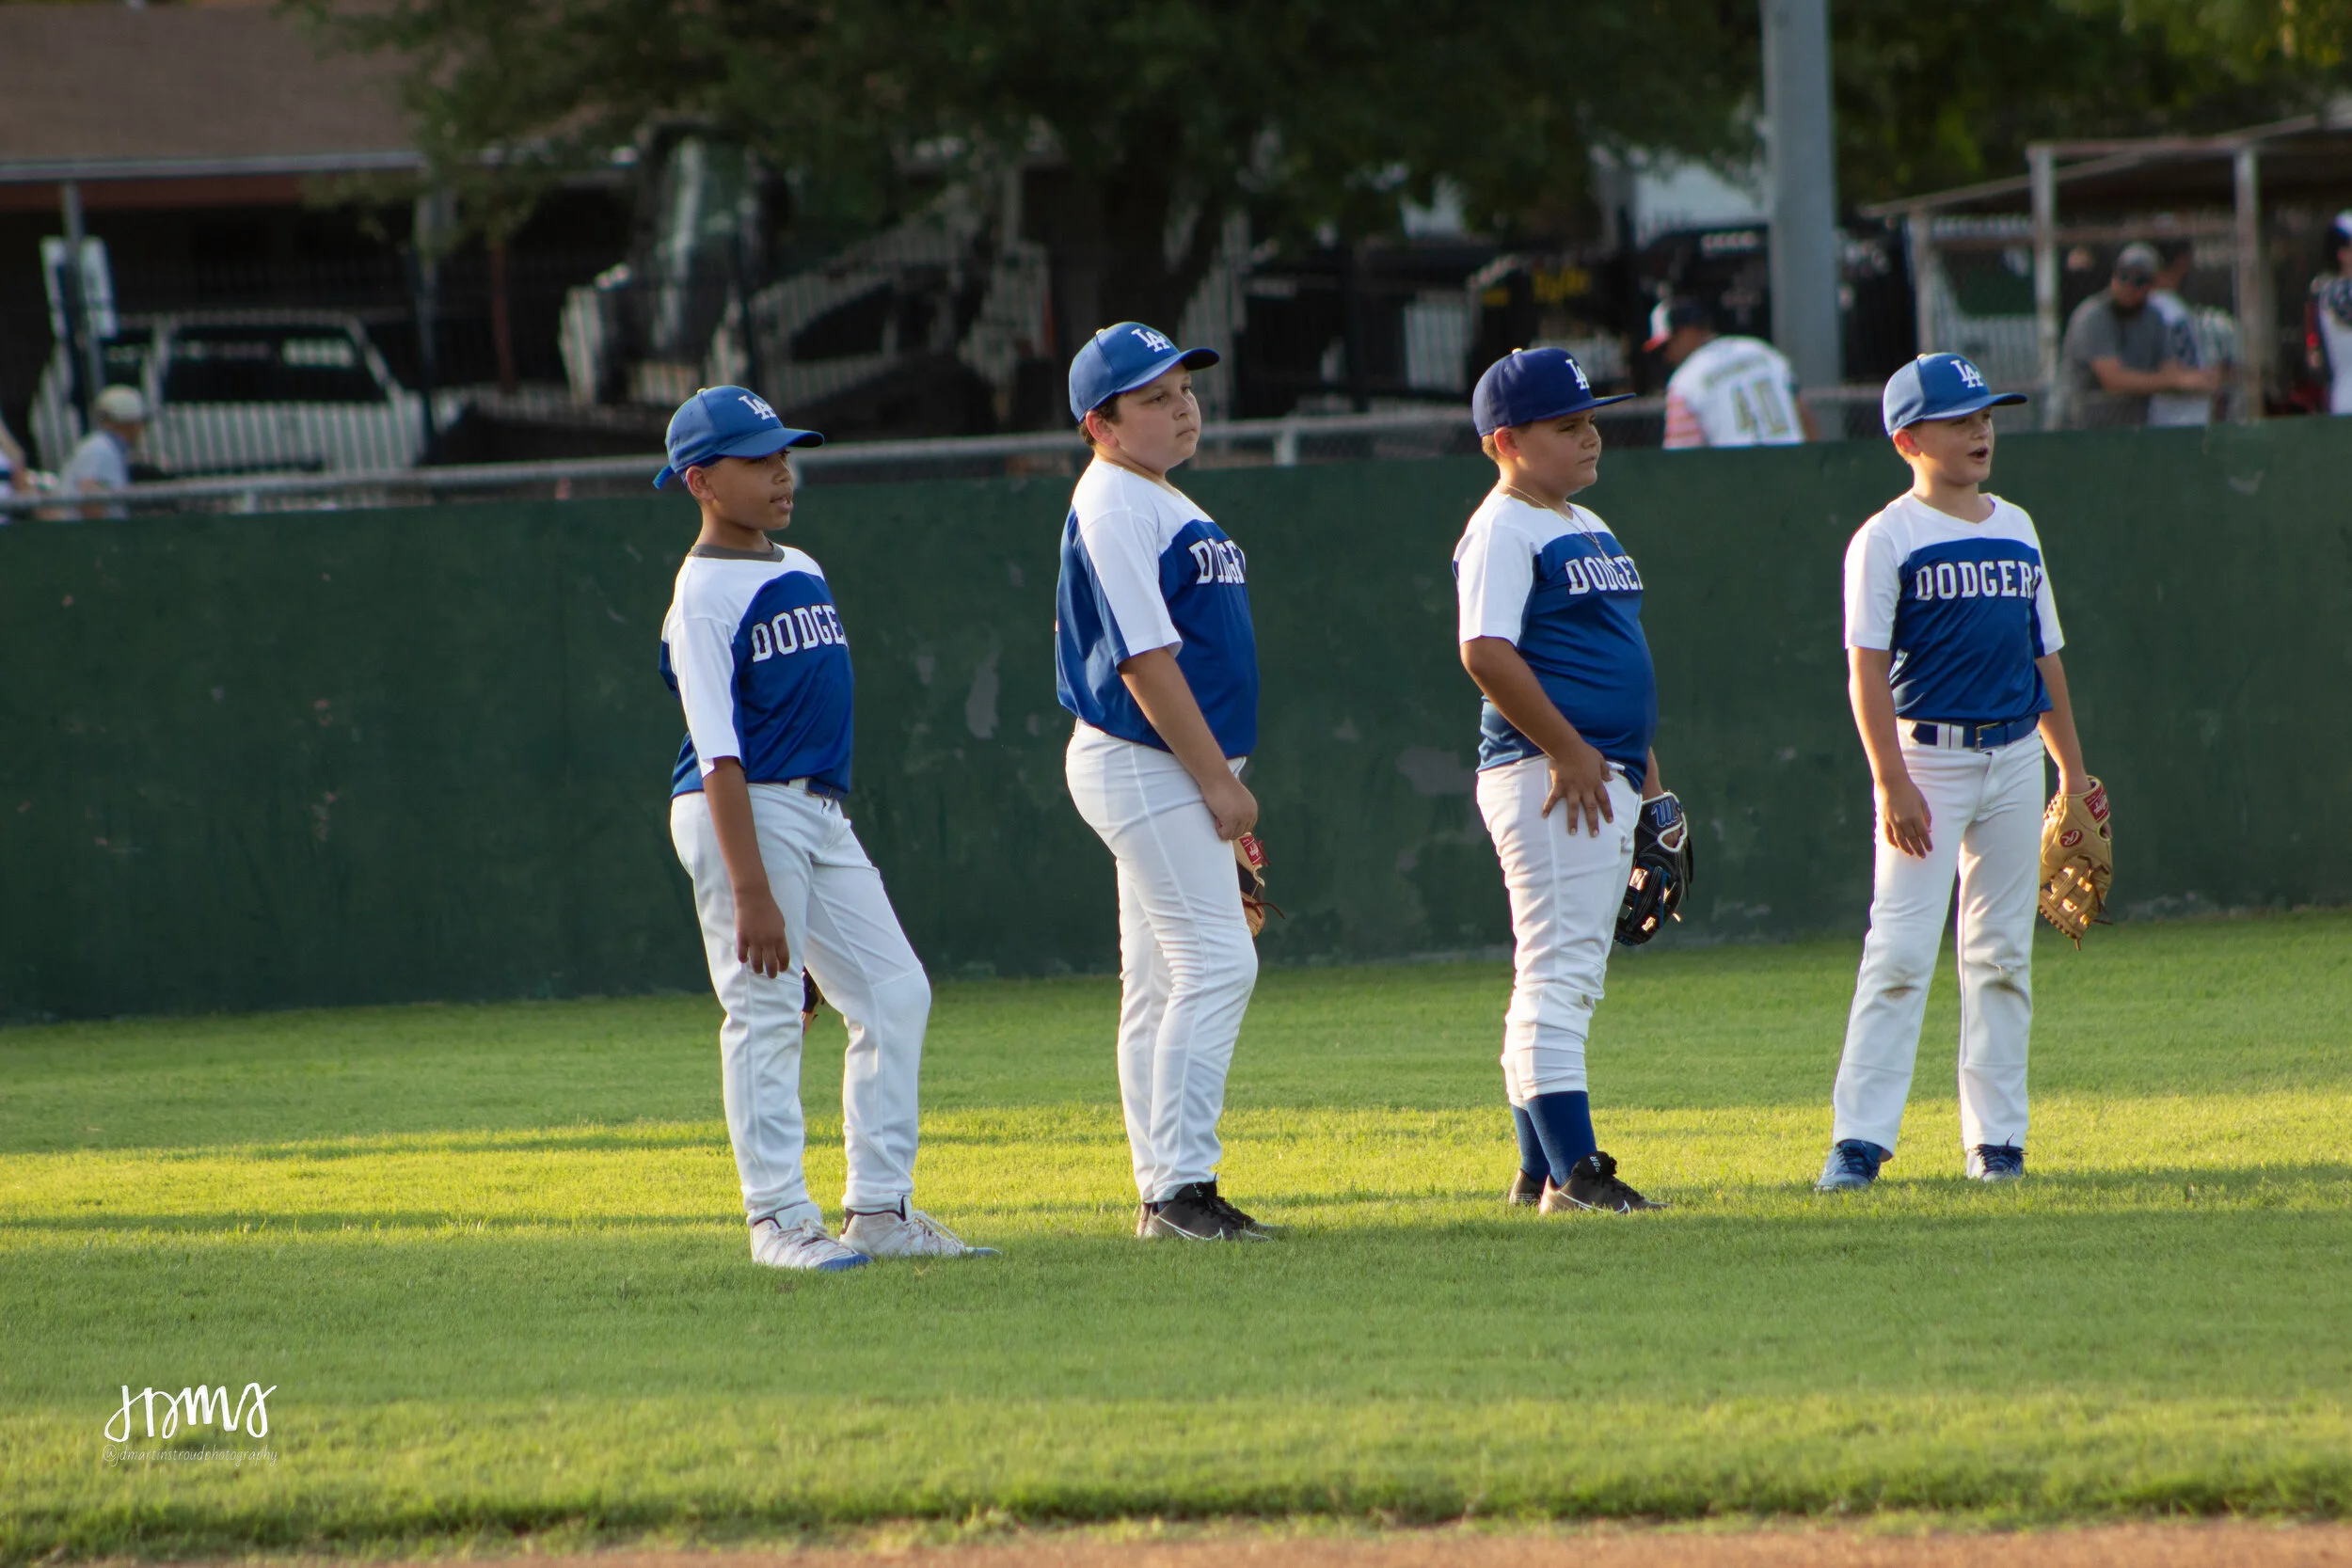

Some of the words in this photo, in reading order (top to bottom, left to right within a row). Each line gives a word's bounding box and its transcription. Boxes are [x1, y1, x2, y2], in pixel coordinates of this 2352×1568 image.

[1131, 328, 1171, 353] LA
[1950, 359, 1985, 388] LA
[739, 395, 777, 421] LA
[751, 604, 849, 663] DODGE
